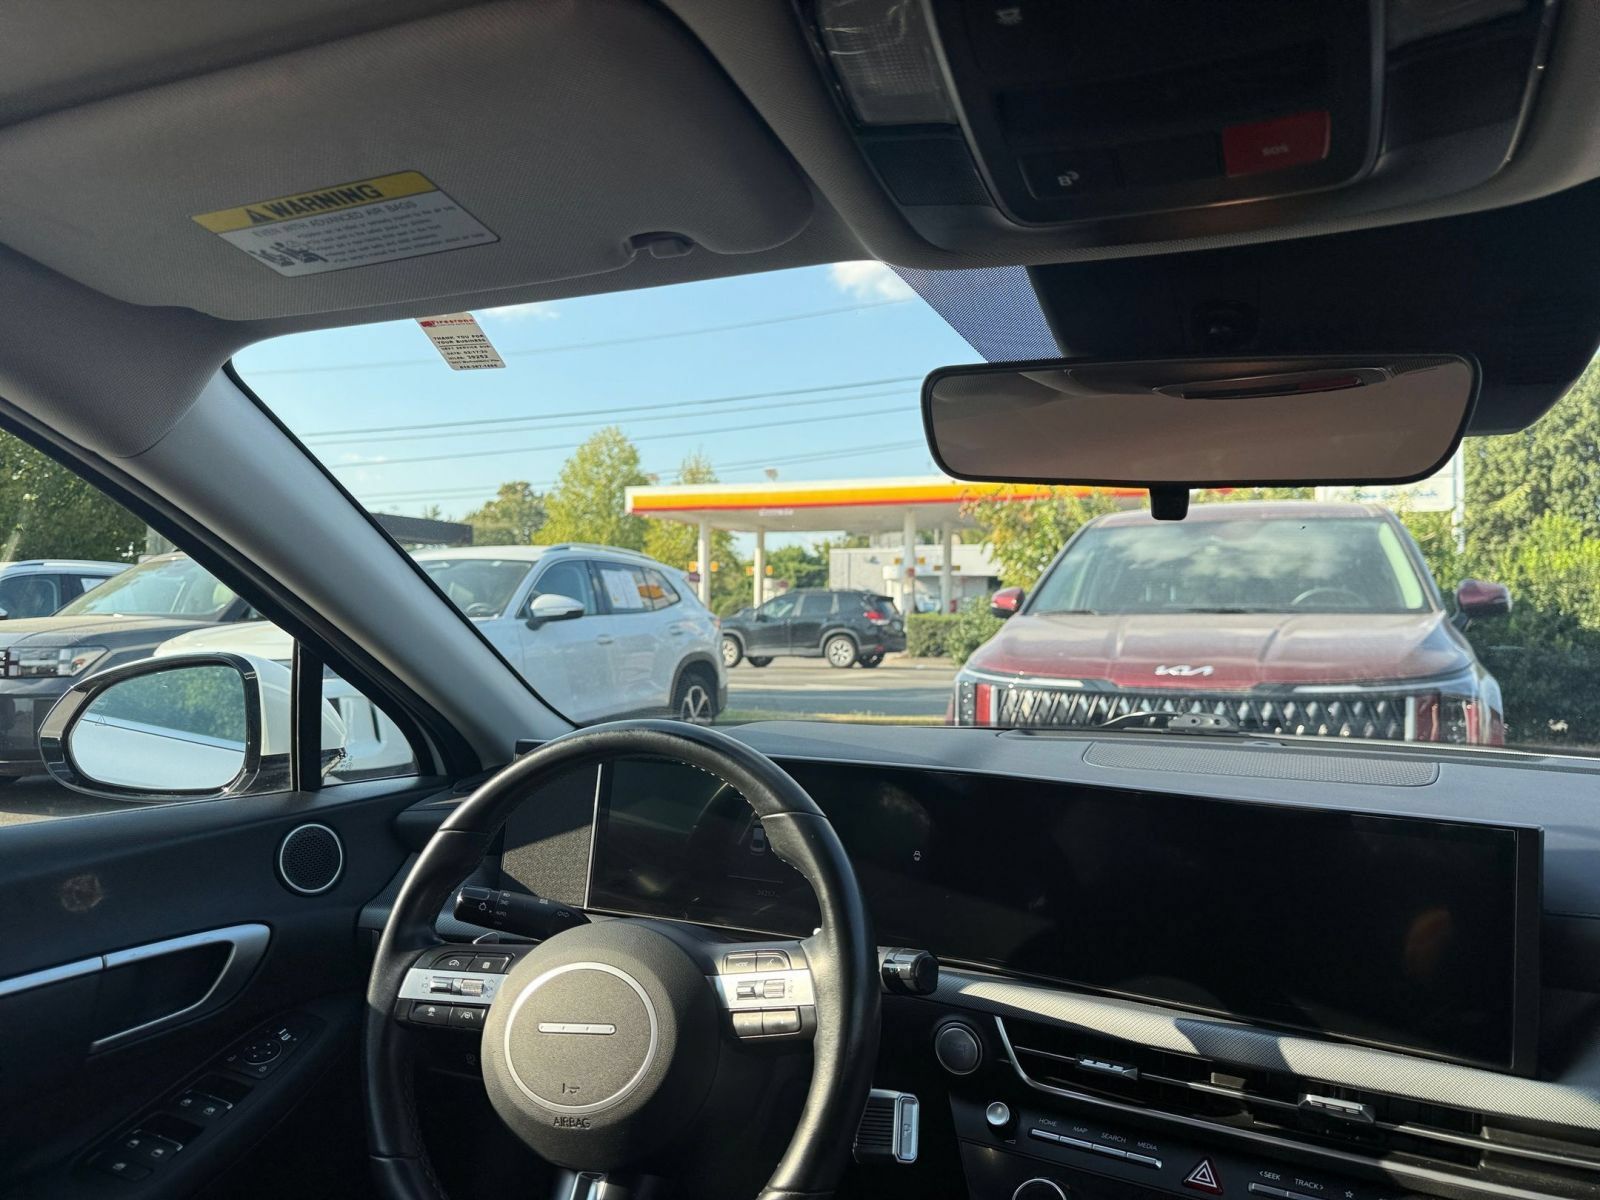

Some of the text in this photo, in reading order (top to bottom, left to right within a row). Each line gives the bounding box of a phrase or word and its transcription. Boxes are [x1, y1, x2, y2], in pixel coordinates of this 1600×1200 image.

[262, 184, 384, 218] WARNING
[309, 210, 364, 226] ADVANCED
[365, 206, 384, 216] AIR
[385, 200, 418, 213] BAGS
[553, 1116, 591, 1128] AIRBAG
[1039, 1118, 1057, 1127] HOME
[1073, 1126, 1088, 1134] MAP
[1101, 1132, 1127, 1143] SEARCH
[1137, 1141, 1158, 1151] MEDIA
